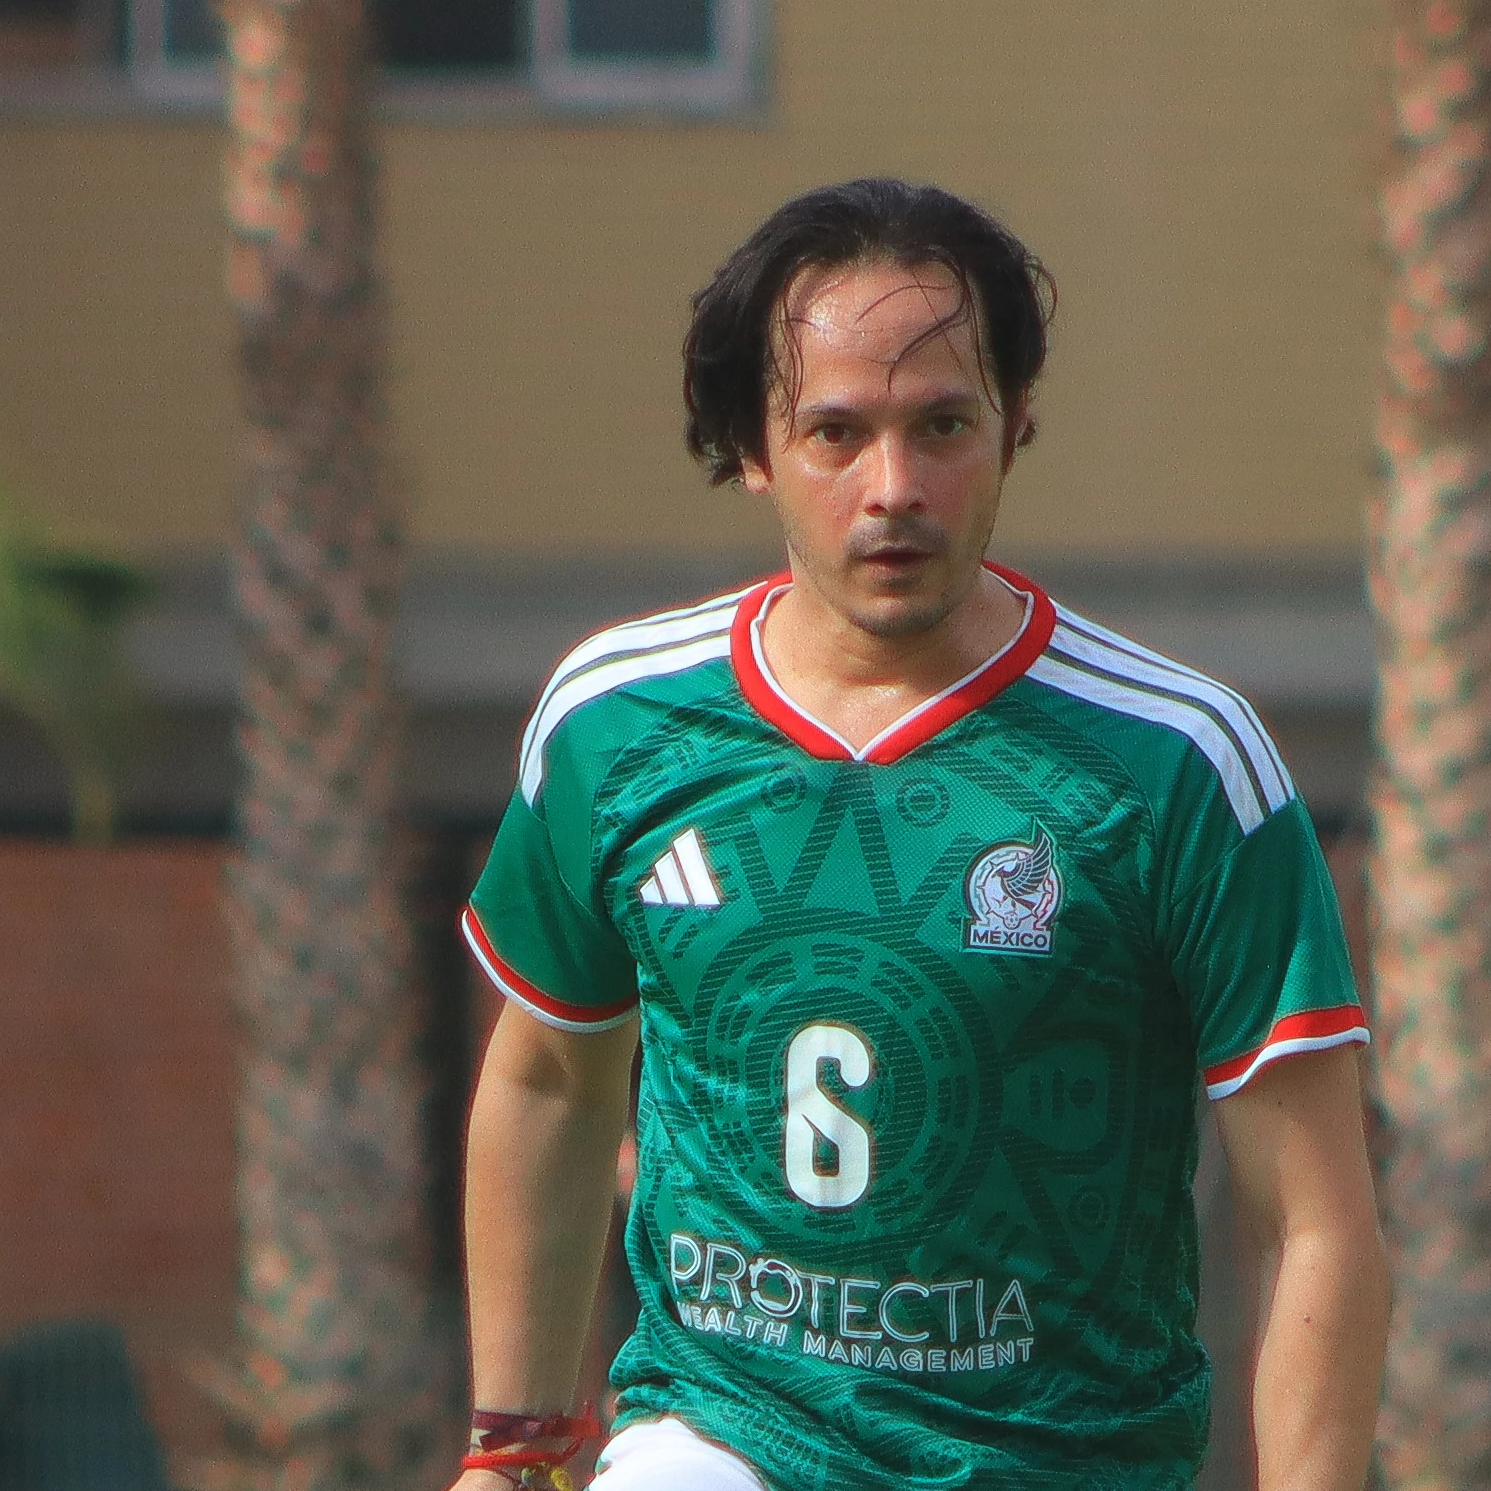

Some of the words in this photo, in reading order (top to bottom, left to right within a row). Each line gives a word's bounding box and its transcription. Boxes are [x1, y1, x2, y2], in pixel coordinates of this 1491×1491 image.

[972, 926, 1048, 948] MÉXICO
[785, 1025, 870, 1207] 6
[669, 1234, 1034, 1343] PROTECTIA
[676, 1301, 788, 1348] WEALTH
[802, 1337, 1035, 1373] MANAGEMENT
